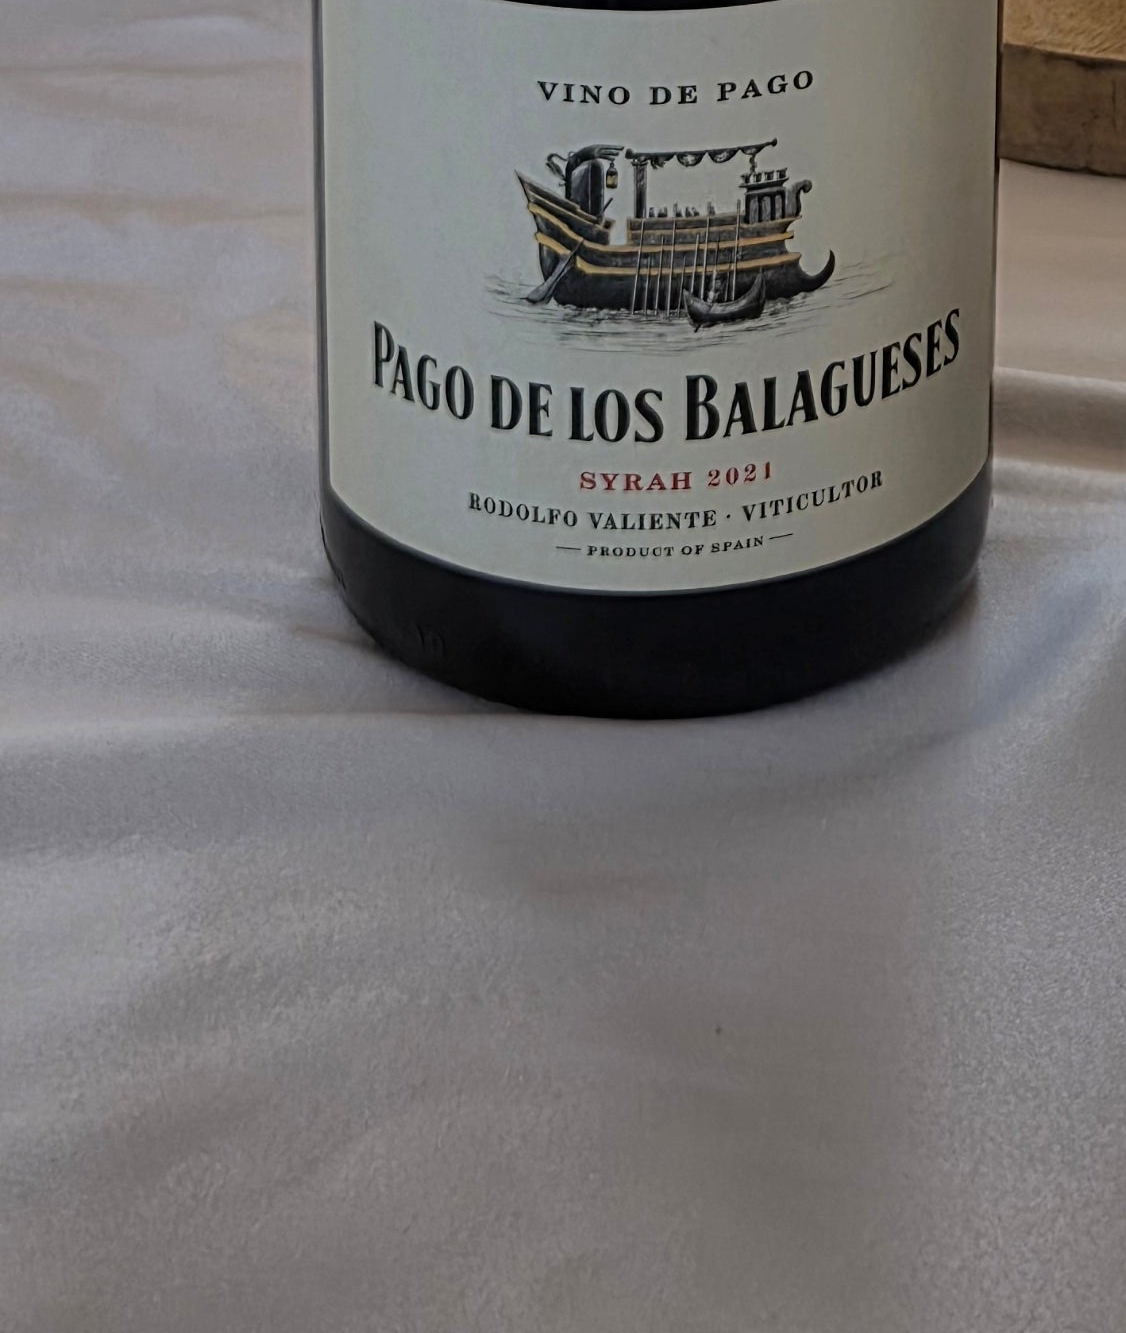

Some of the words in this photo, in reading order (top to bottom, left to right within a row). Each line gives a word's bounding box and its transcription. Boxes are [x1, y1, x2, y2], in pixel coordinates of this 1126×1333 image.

[537, 79, 631, 106] VINO
[649, 84, 698, 106] DE
[716, 70, 815, 102] PAGO
[373, 320, 475, 420] PAGO
[490, 374, 553, 438] DE
[568, 386, 664, 444] LOS
[685, 308, 960, 441] BALAGUESES
[579, 471, 693, 492] SYRAH
[707, 461, 772, 488] 2021
[468, 492, 578, 528] RODOLFO
[587, 509, 717, 531] VALIENTE
[741, 470, 883, 522] VITICULTOR
[586, 544, 675, 558] PRODUCT
[680, 544, 704, 557] OF
[710, 535, 764, 554] SPAIN
